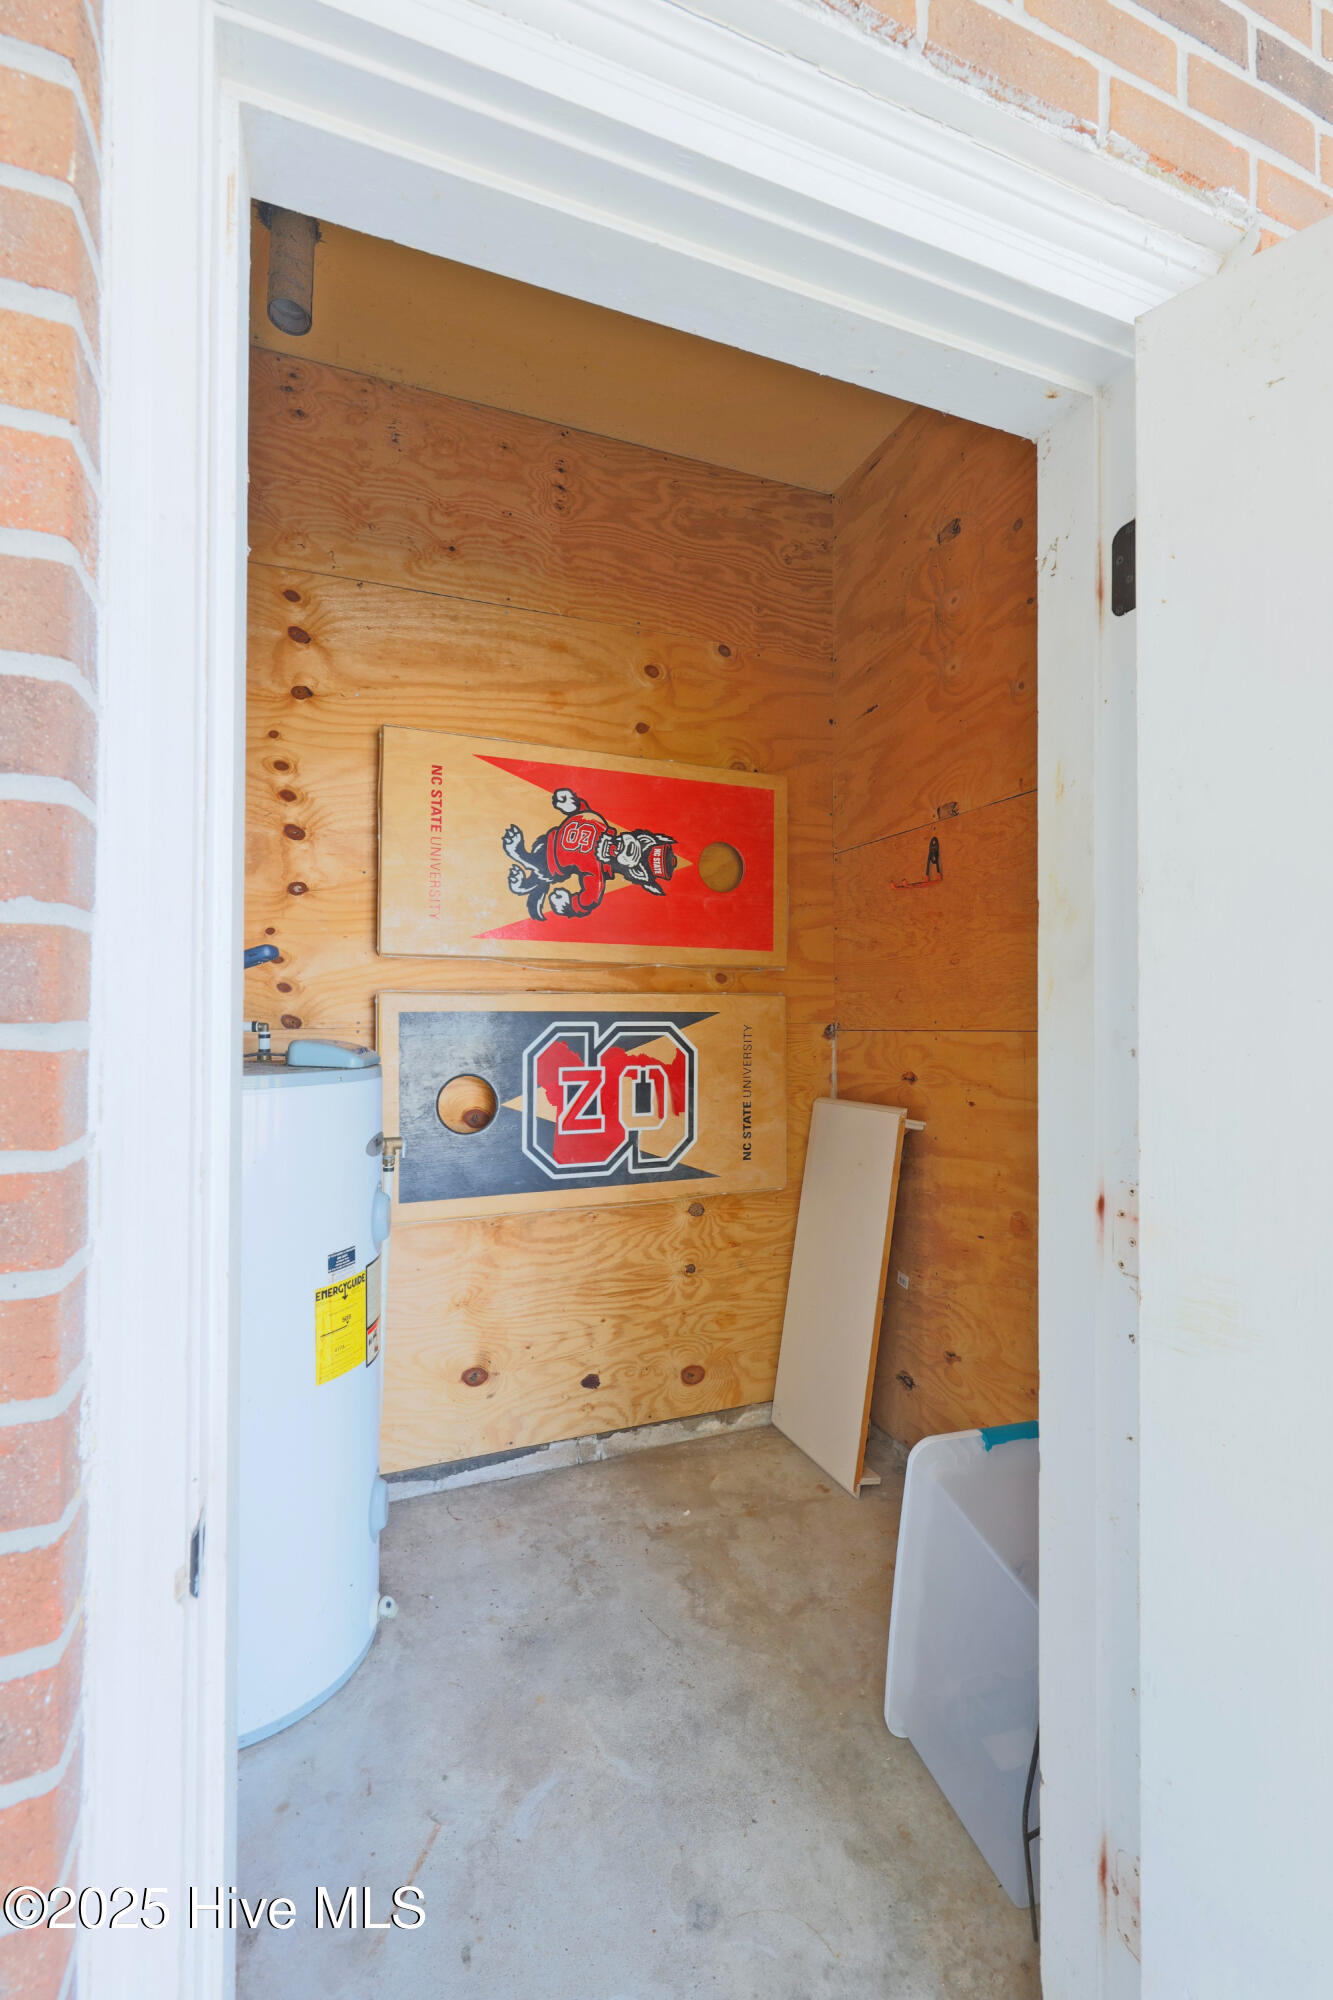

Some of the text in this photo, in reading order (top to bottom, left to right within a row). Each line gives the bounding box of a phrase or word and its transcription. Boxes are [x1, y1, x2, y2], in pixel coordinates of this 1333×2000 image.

[428, 764, 443, 921] NC STATE UNIVERSITY
[653, 857, 662, 874] STATE
[742, 1024, 753, 1161] NC STATE UNIVERSITY
